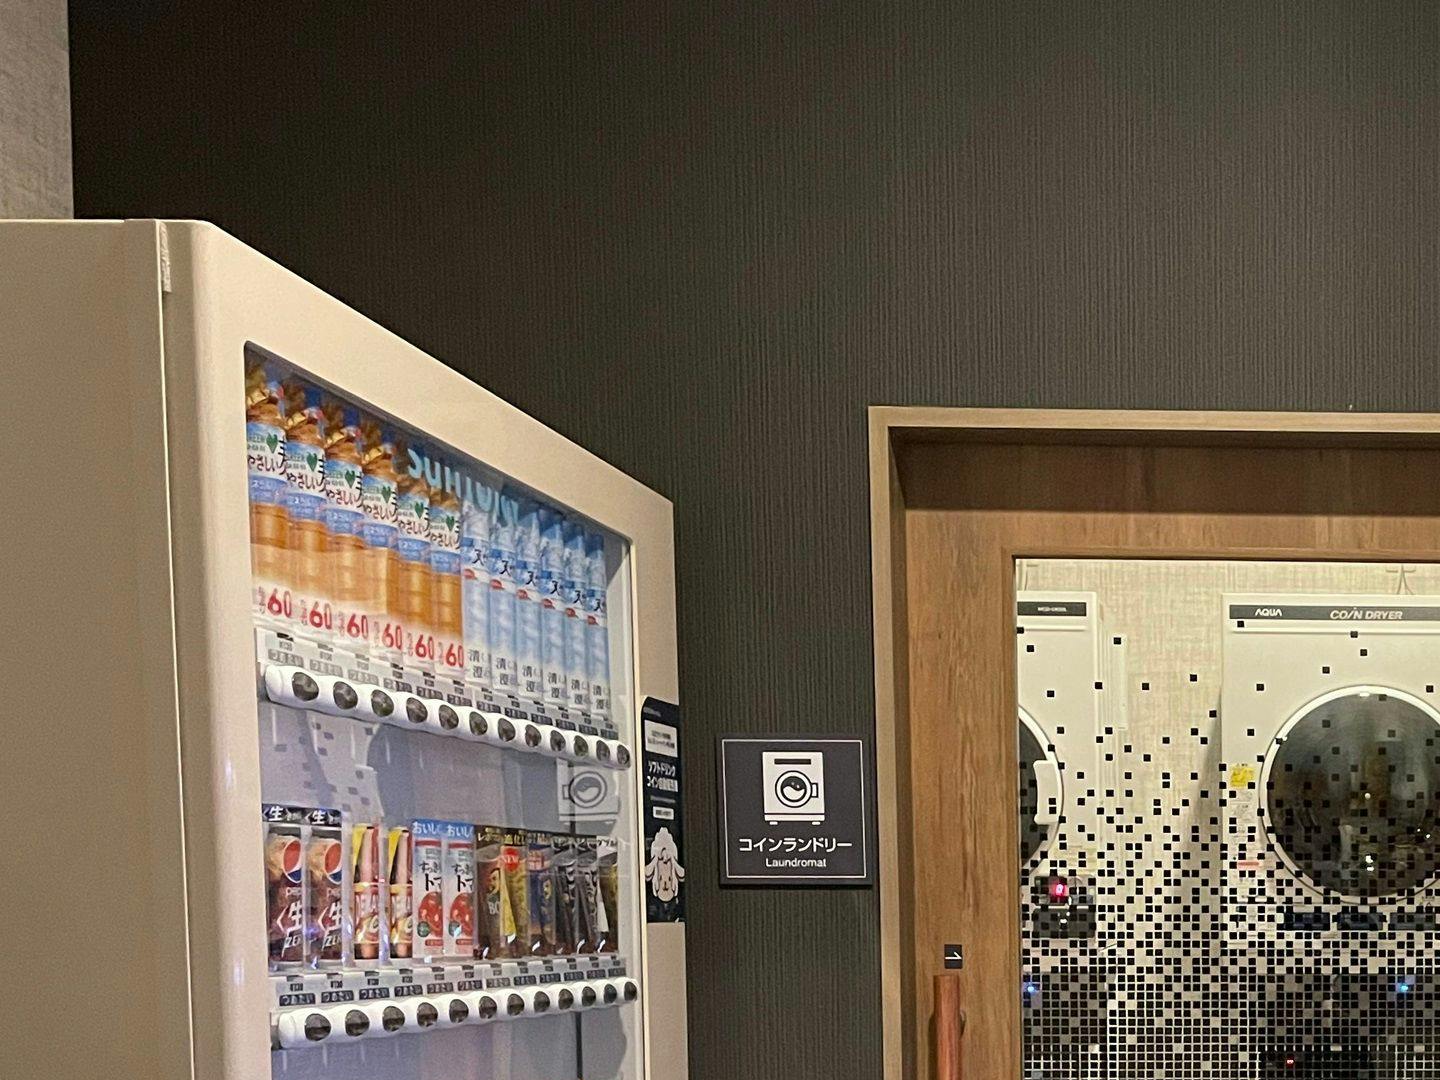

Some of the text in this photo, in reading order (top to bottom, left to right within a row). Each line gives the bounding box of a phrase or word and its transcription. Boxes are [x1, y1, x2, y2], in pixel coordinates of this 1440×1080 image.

[1255, 608, 1282, 617] AQUA
[1365, 610, 1403, 620] DRYER
[739, 837, 852, 853] コインランドリー
[765, 858, 827, 868] Laundromat
